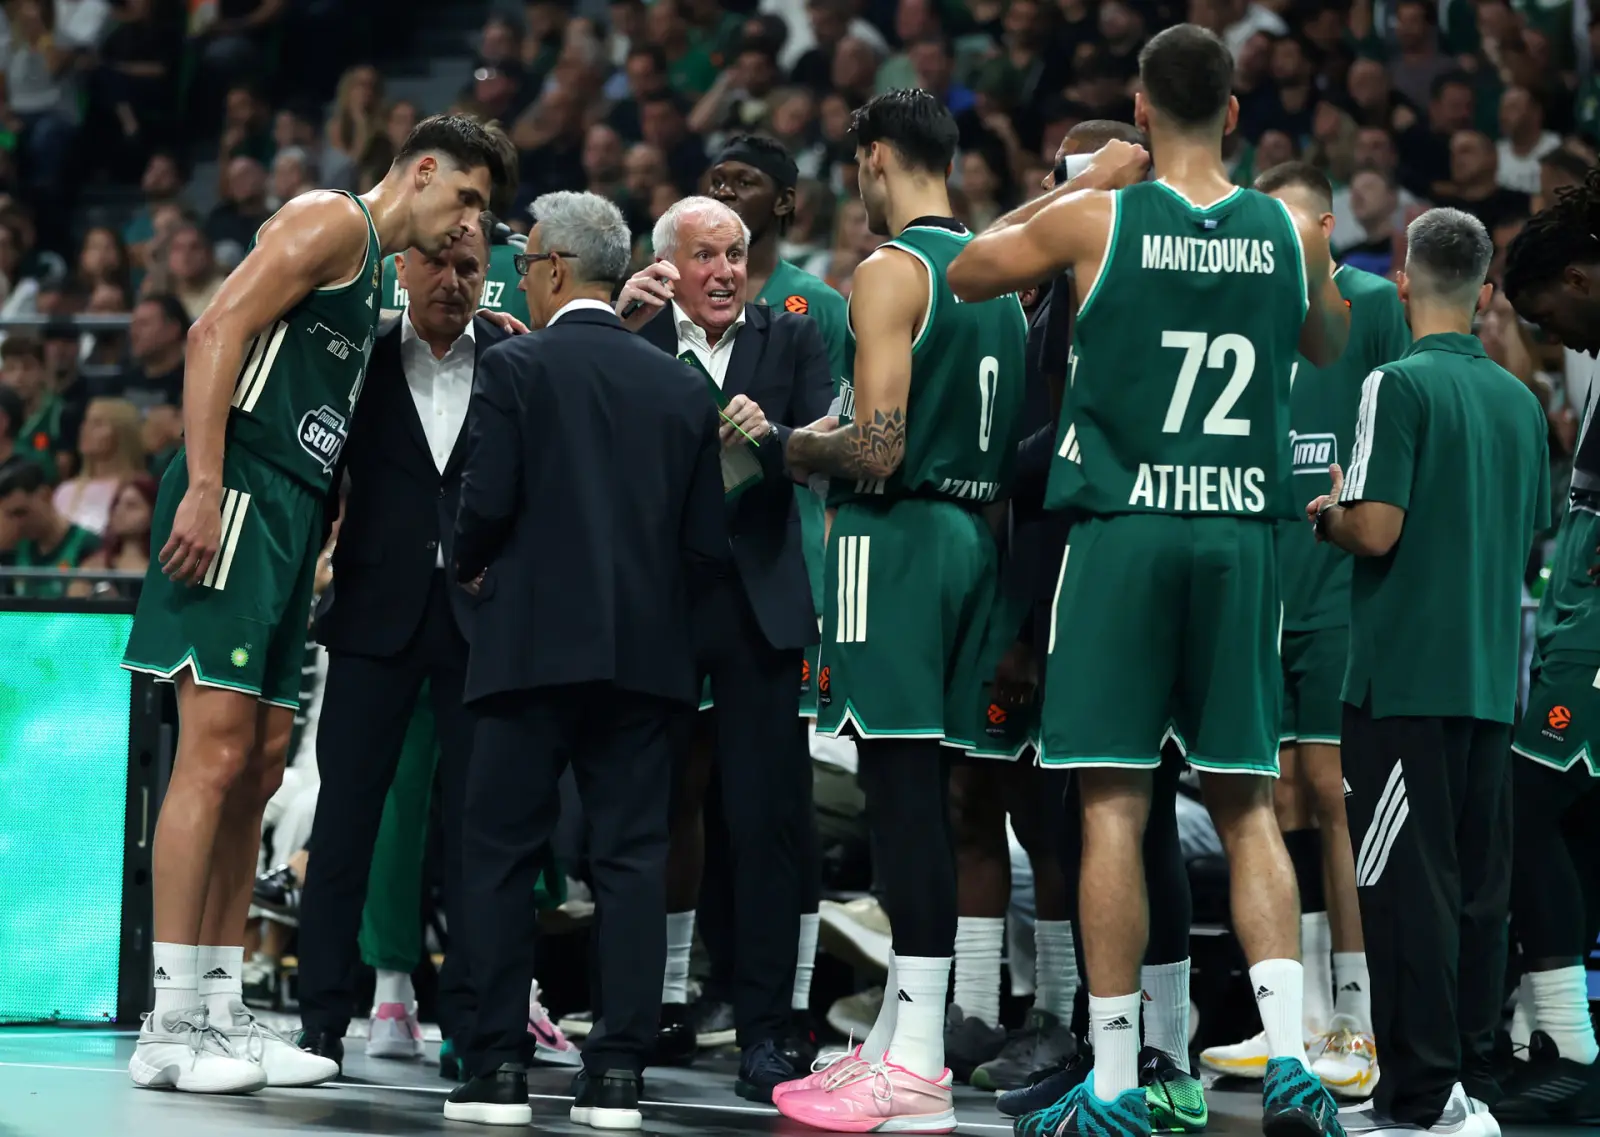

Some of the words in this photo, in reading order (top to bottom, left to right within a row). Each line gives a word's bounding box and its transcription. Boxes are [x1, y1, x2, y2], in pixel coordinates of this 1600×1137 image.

[1142, 234, 1275, 275] MANTZOUKAS
[979, 355, 999, 452] 0
[1161, 330, 1256, 436] 72
[1128, 462, 1266, 513] ATHENS
